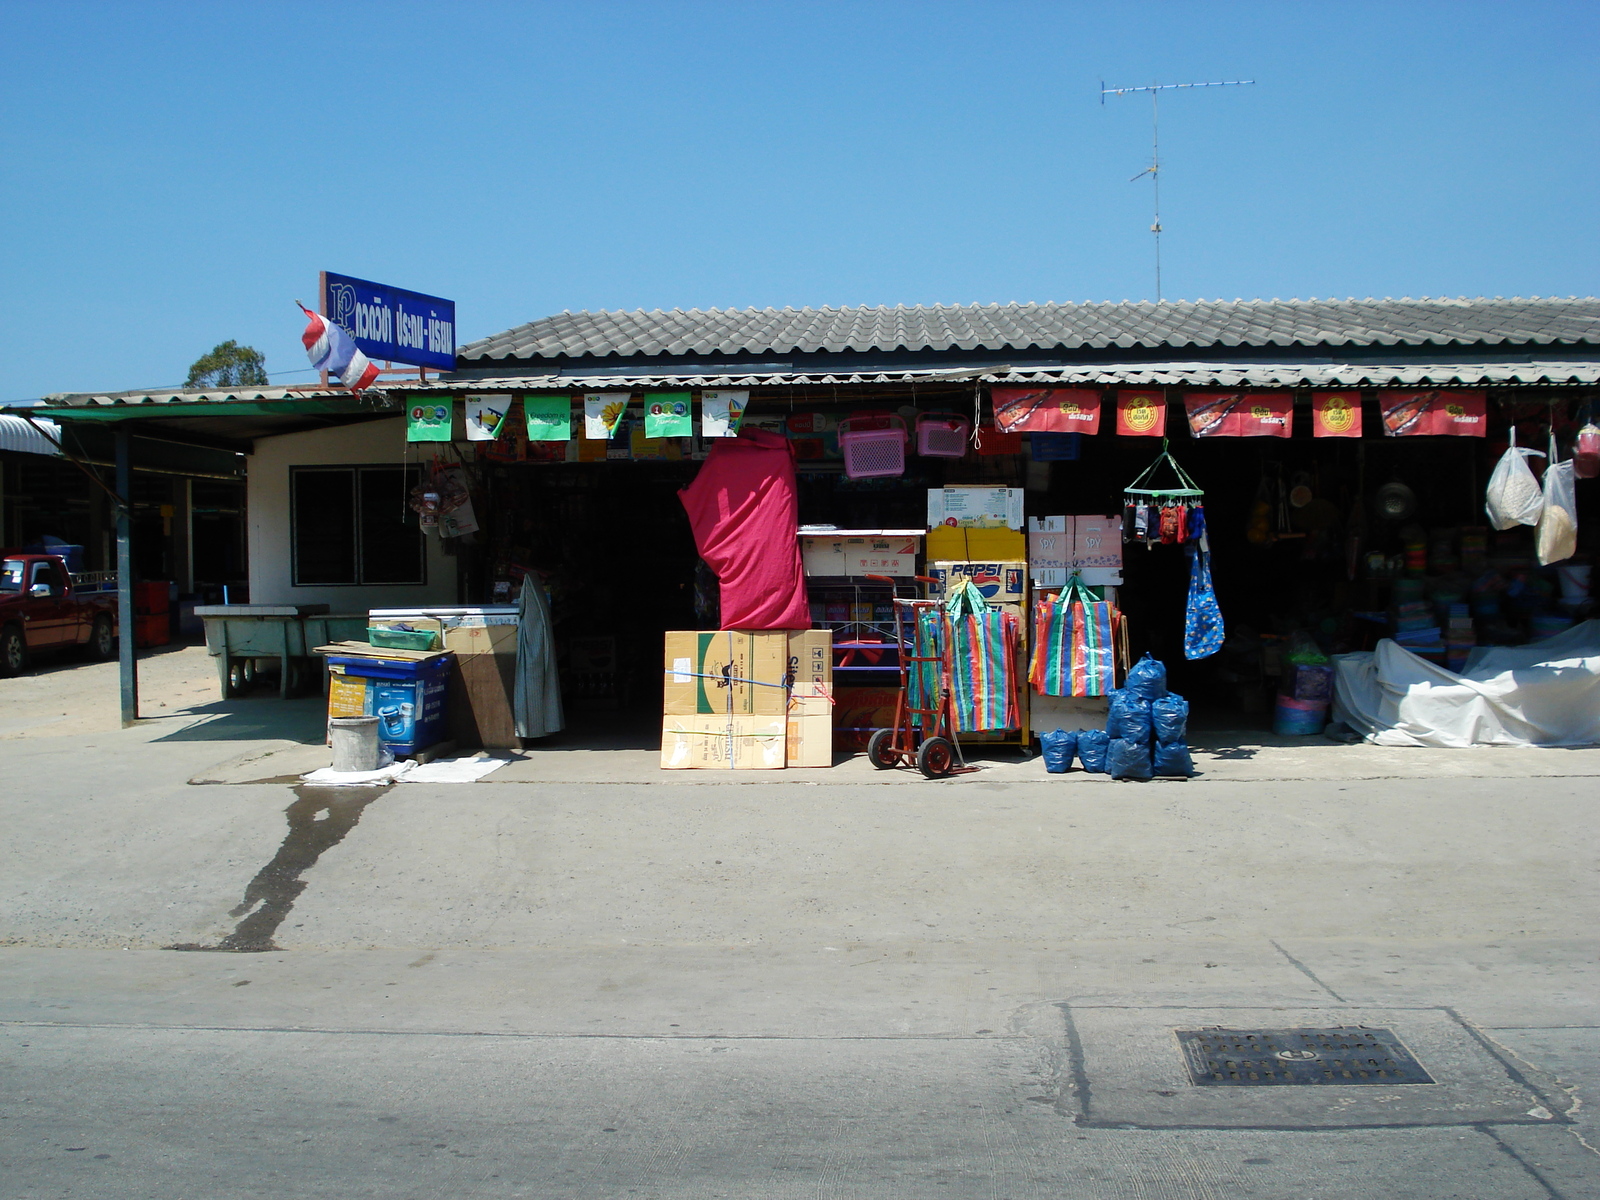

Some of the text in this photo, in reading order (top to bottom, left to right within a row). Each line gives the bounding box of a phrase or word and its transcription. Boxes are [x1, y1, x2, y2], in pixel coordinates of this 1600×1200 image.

[355, 297, 453, 355] กวดวิชา ประถม-มัธยม
[1040, 536, 1056, 550] SPY
[1086, 534, 1101, 548] SPY
[951, 564, 1003, 577] PEPSI
